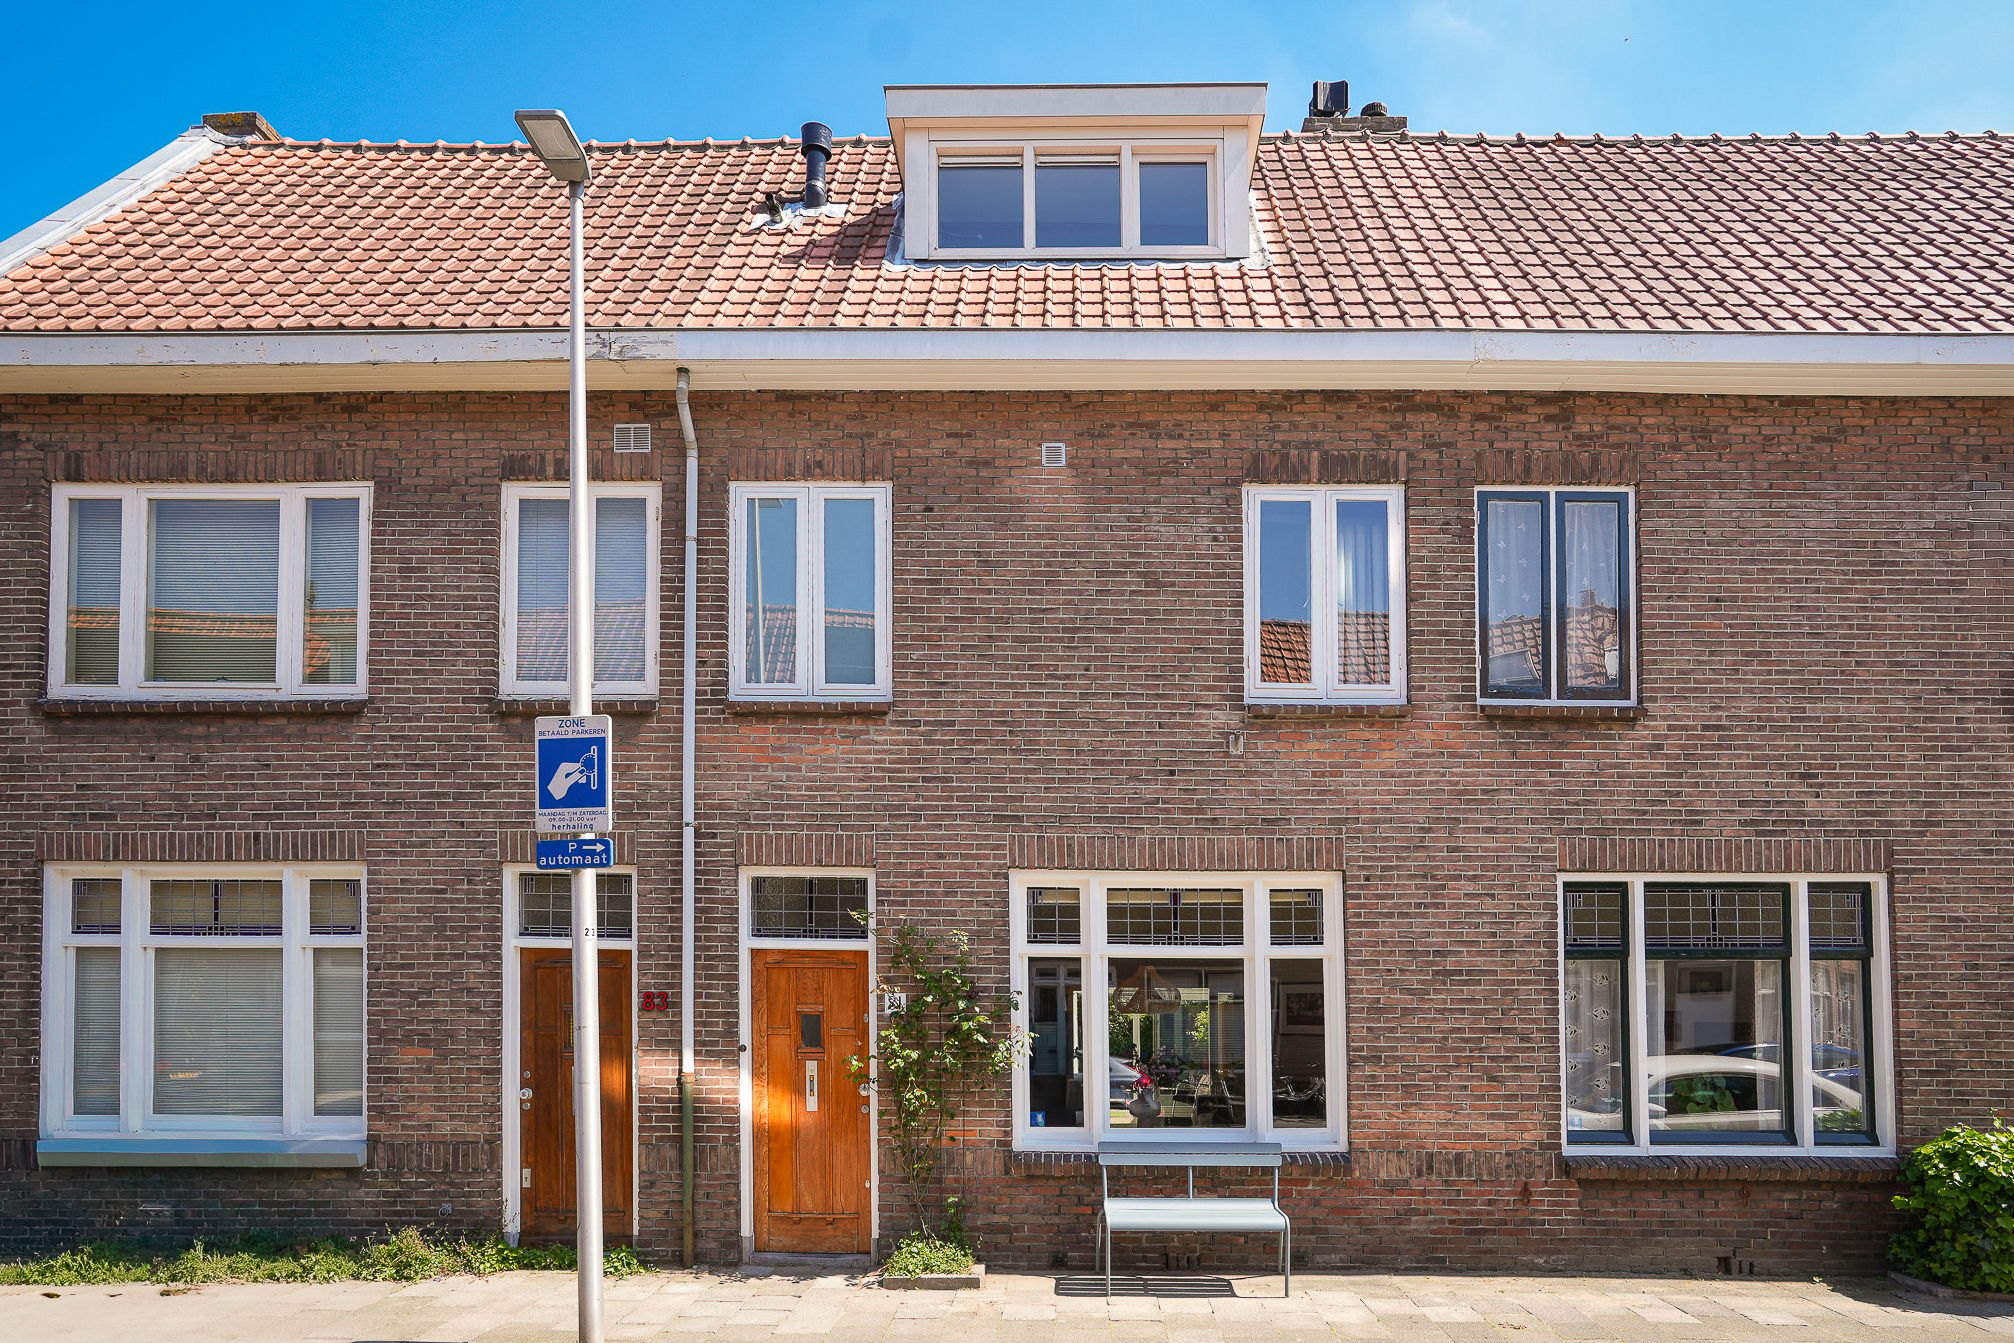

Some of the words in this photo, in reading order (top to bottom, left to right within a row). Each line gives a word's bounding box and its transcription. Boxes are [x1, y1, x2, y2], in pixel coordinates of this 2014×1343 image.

[558, 718, 586, 728] ZONE
[551, 823, 594, 831] herhaling
[568, 842, 578, 853] P
[539, 853, 608, 865] automaat
[642, 991, 669, 1011] 83
